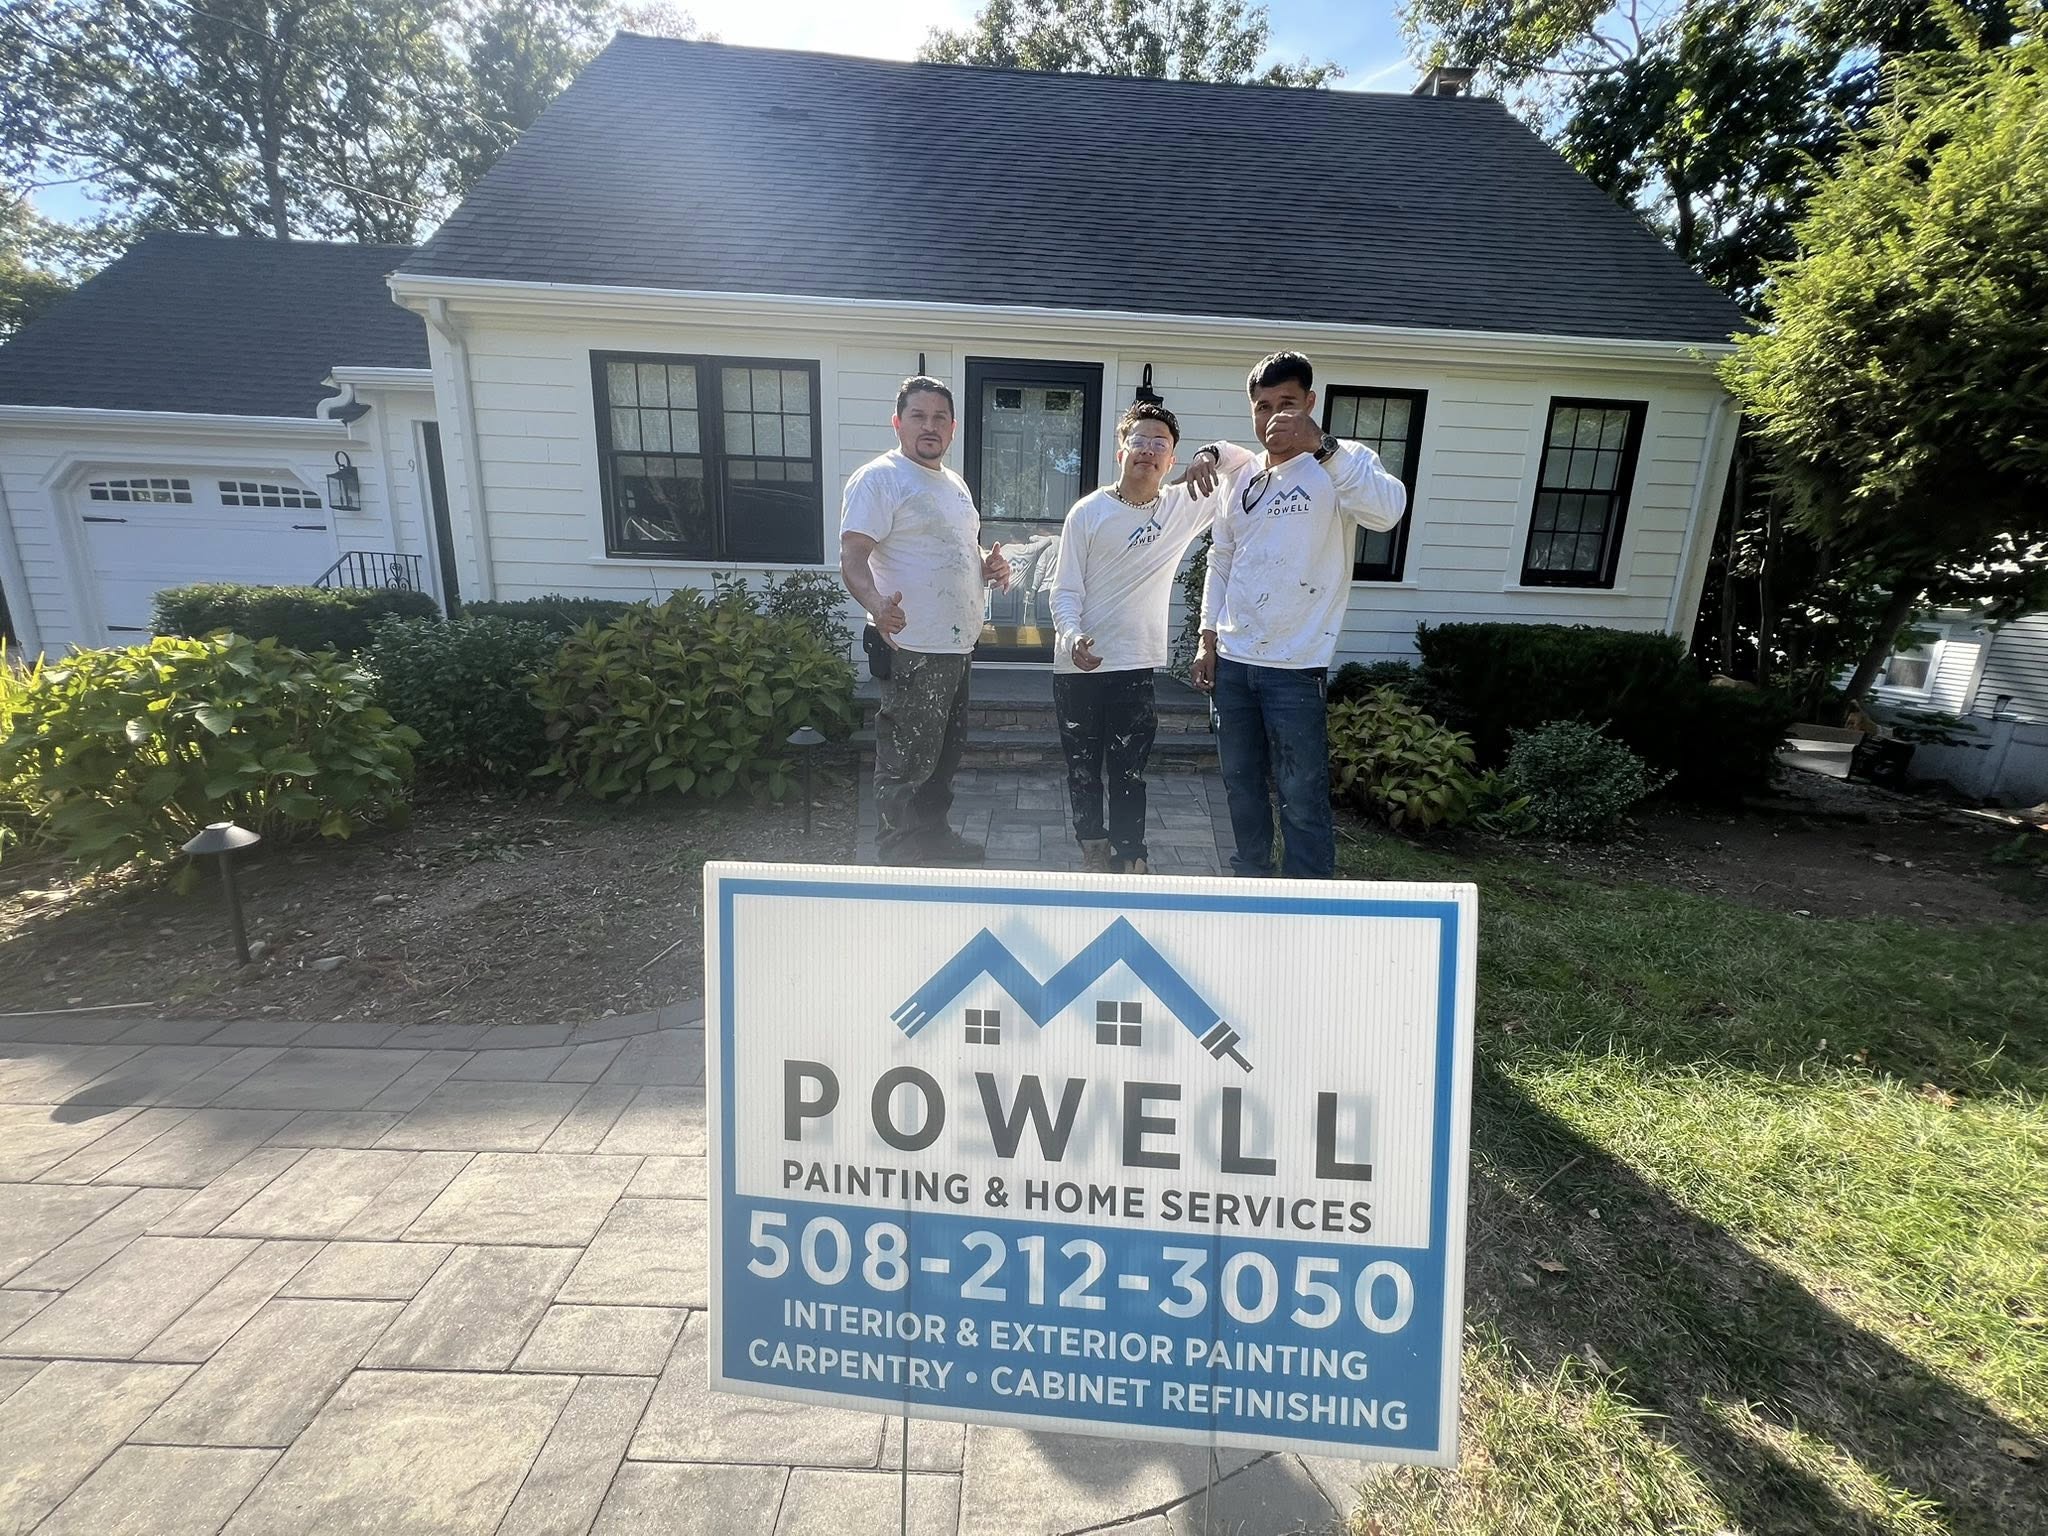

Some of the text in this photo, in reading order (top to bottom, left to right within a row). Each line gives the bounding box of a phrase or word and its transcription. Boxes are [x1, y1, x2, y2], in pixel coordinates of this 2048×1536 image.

[408, 459, 415, 473] 9
[1267, 503, 1309, 516] POWELL
[784, 1059, 1372, 1181] POWELL
[783, 1159, 1372, 1233] PAINTING & HOME SERVICES
[747, 1210, 1415, 1334] 508-212-3050
[784, 1299, 1368, 1381] INTERIOR & EXTERIOR PAINTING
[748, 1338, 1408, 1431] CARPENTRY CABINET REFINISHING
